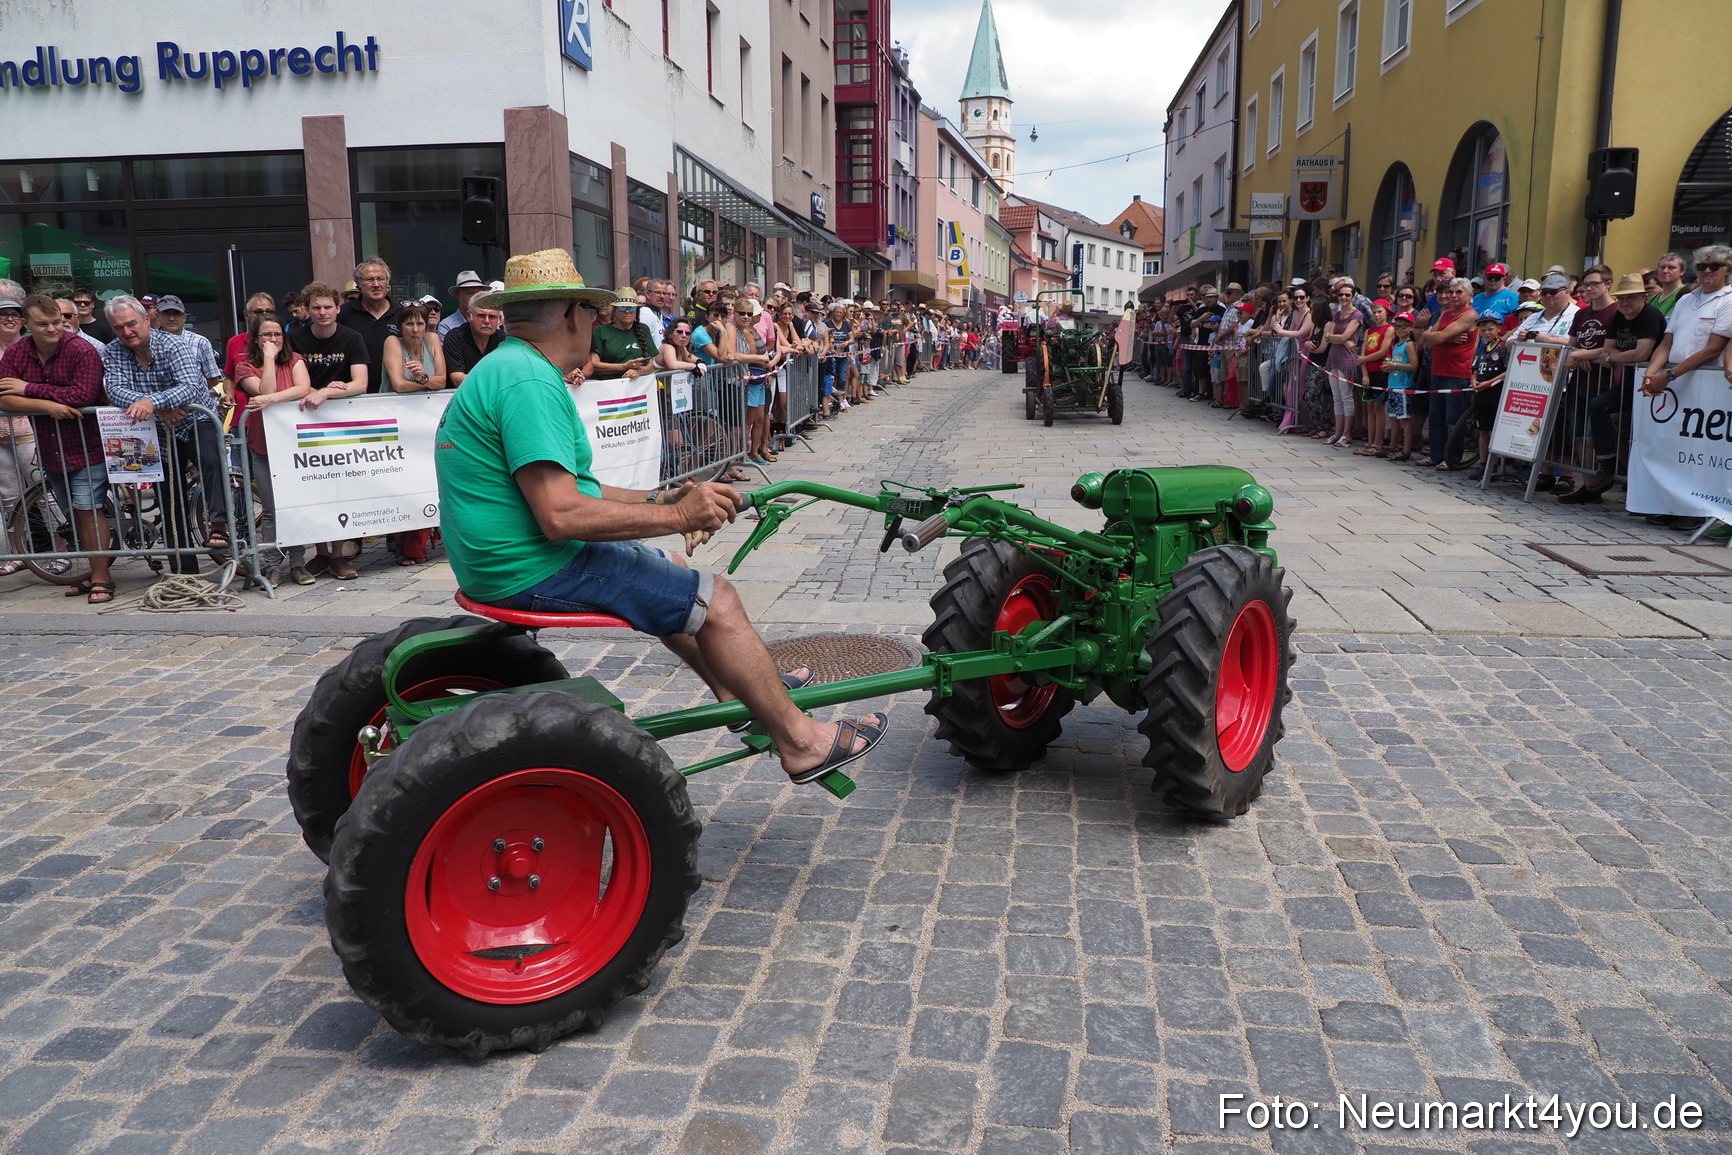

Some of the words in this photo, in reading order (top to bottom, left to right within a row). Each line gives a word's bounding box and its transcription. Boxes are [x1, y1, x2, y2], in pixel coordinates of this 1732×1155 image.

[0, 46, 140, 93] ndlung
[156, 31, 379, 88] Rupprecht
[1296, 159, 1329, 167] RATHAUS
[1329, 159, 1334, 167] II
[1671, 225, 1700, 234] Digitale
[1702, 225, 1725, 233] Bilder
[950, 250, 961, 260] B
[93, 258, 131, 268] MÄNNER
[34, 266, 69, 275] OLDTIMER
[94, 269, 132, 277] SACHE(N)
[595, 417, 651, 439] NeuerMarkt
[293, 445, 405, 469] NeuerMarkt
[1678, 451, 1704, 466] DAS
[301, 471, 341, 481] einkaufen
[345, 469, 366, 477] leben
[370, 466, 404, 476] genießen
[352, 508, 395, 518] Dammstraße
[352, 517, 386, 527] Neumarkt
